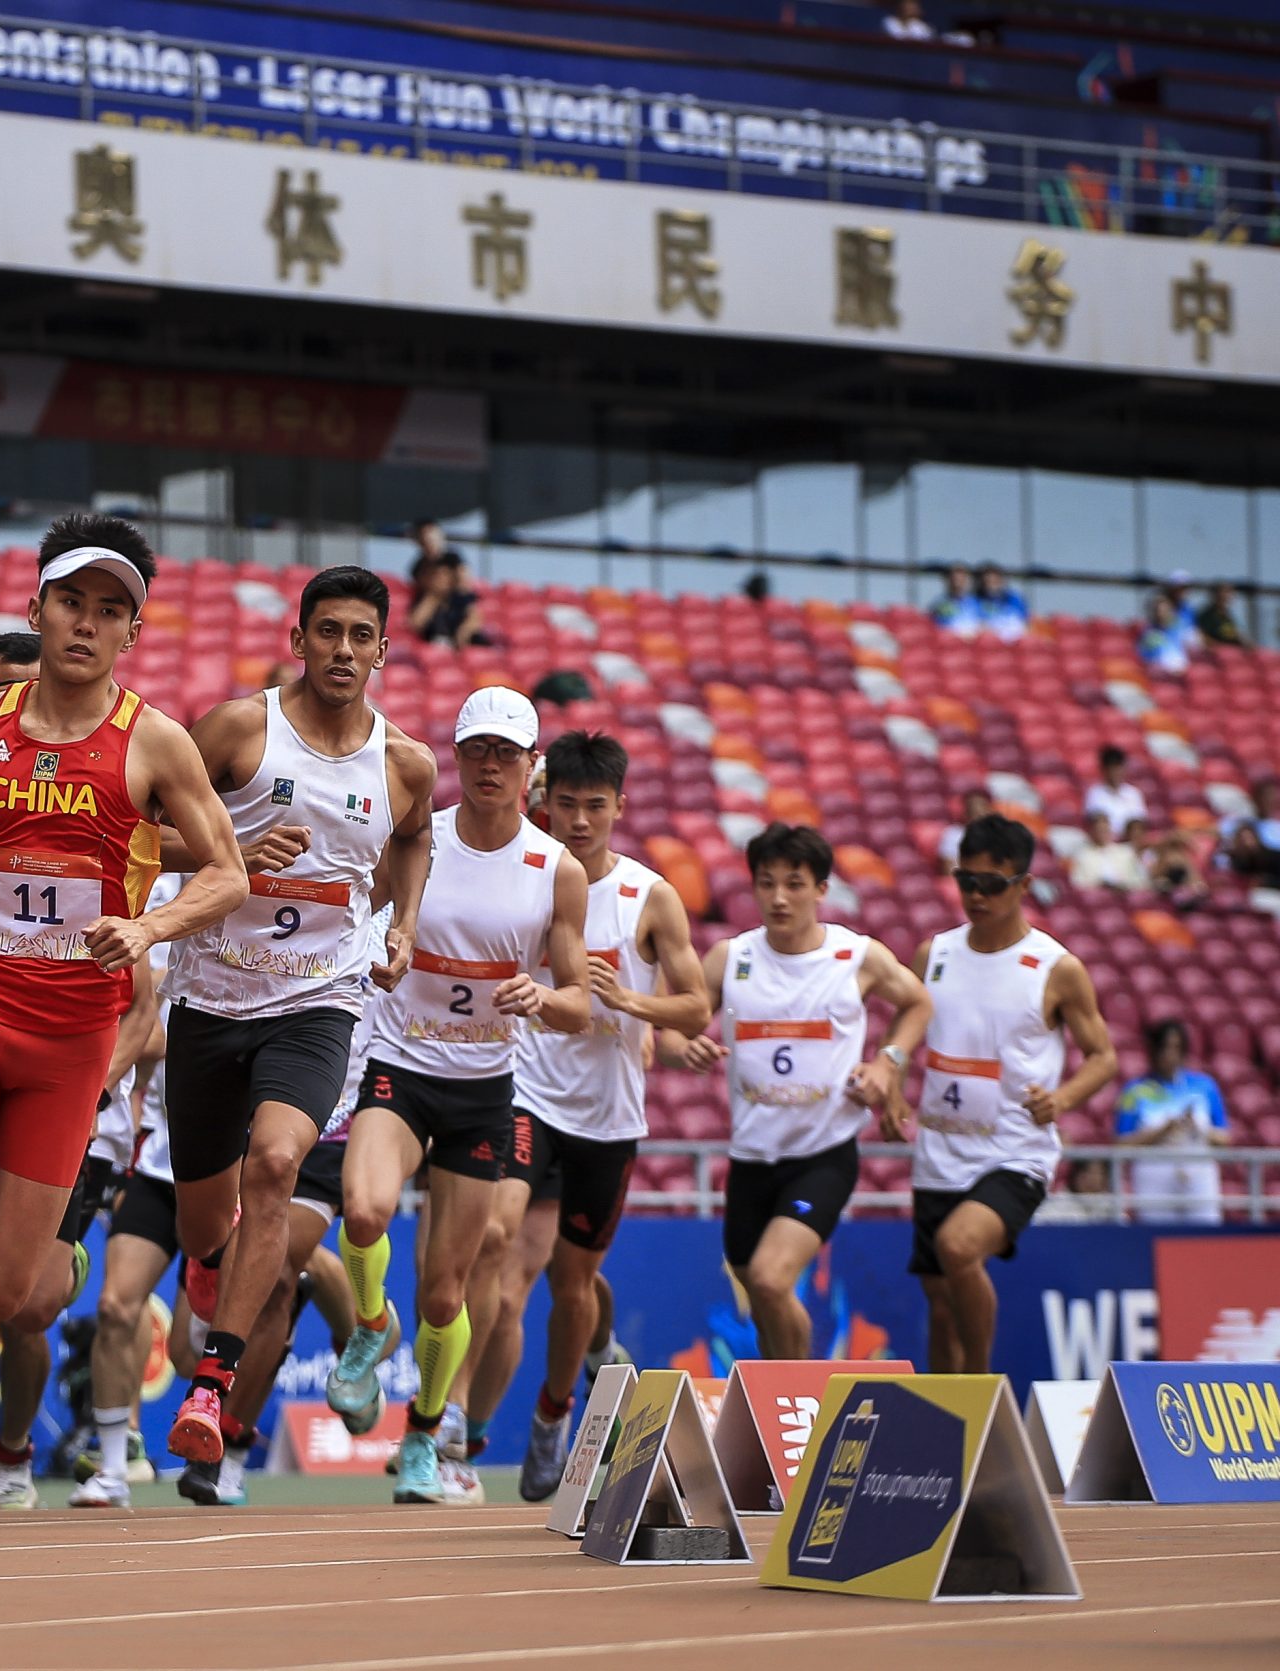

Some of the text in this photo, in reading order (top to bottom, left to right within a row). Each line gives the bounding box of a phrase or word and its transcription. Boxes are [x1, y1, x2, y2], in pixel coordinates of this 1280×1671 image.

[257, 54, 388, 121] Laser
[395, 70, 494, 133] Run
[498, 74, 642, 147] World
[650, 93, 990, 193] Championships
[13, 883, 64, 926] 11
[271, 905, 301, 941] 9
[449, 984, 473, 1016] 2
[772, 1045, 793, 1075] 6
[942, 1081, 962, 1110] 4
[513, 1115, 533, 1166] CHINA
[1208, 1456, 1252, 1482] World
